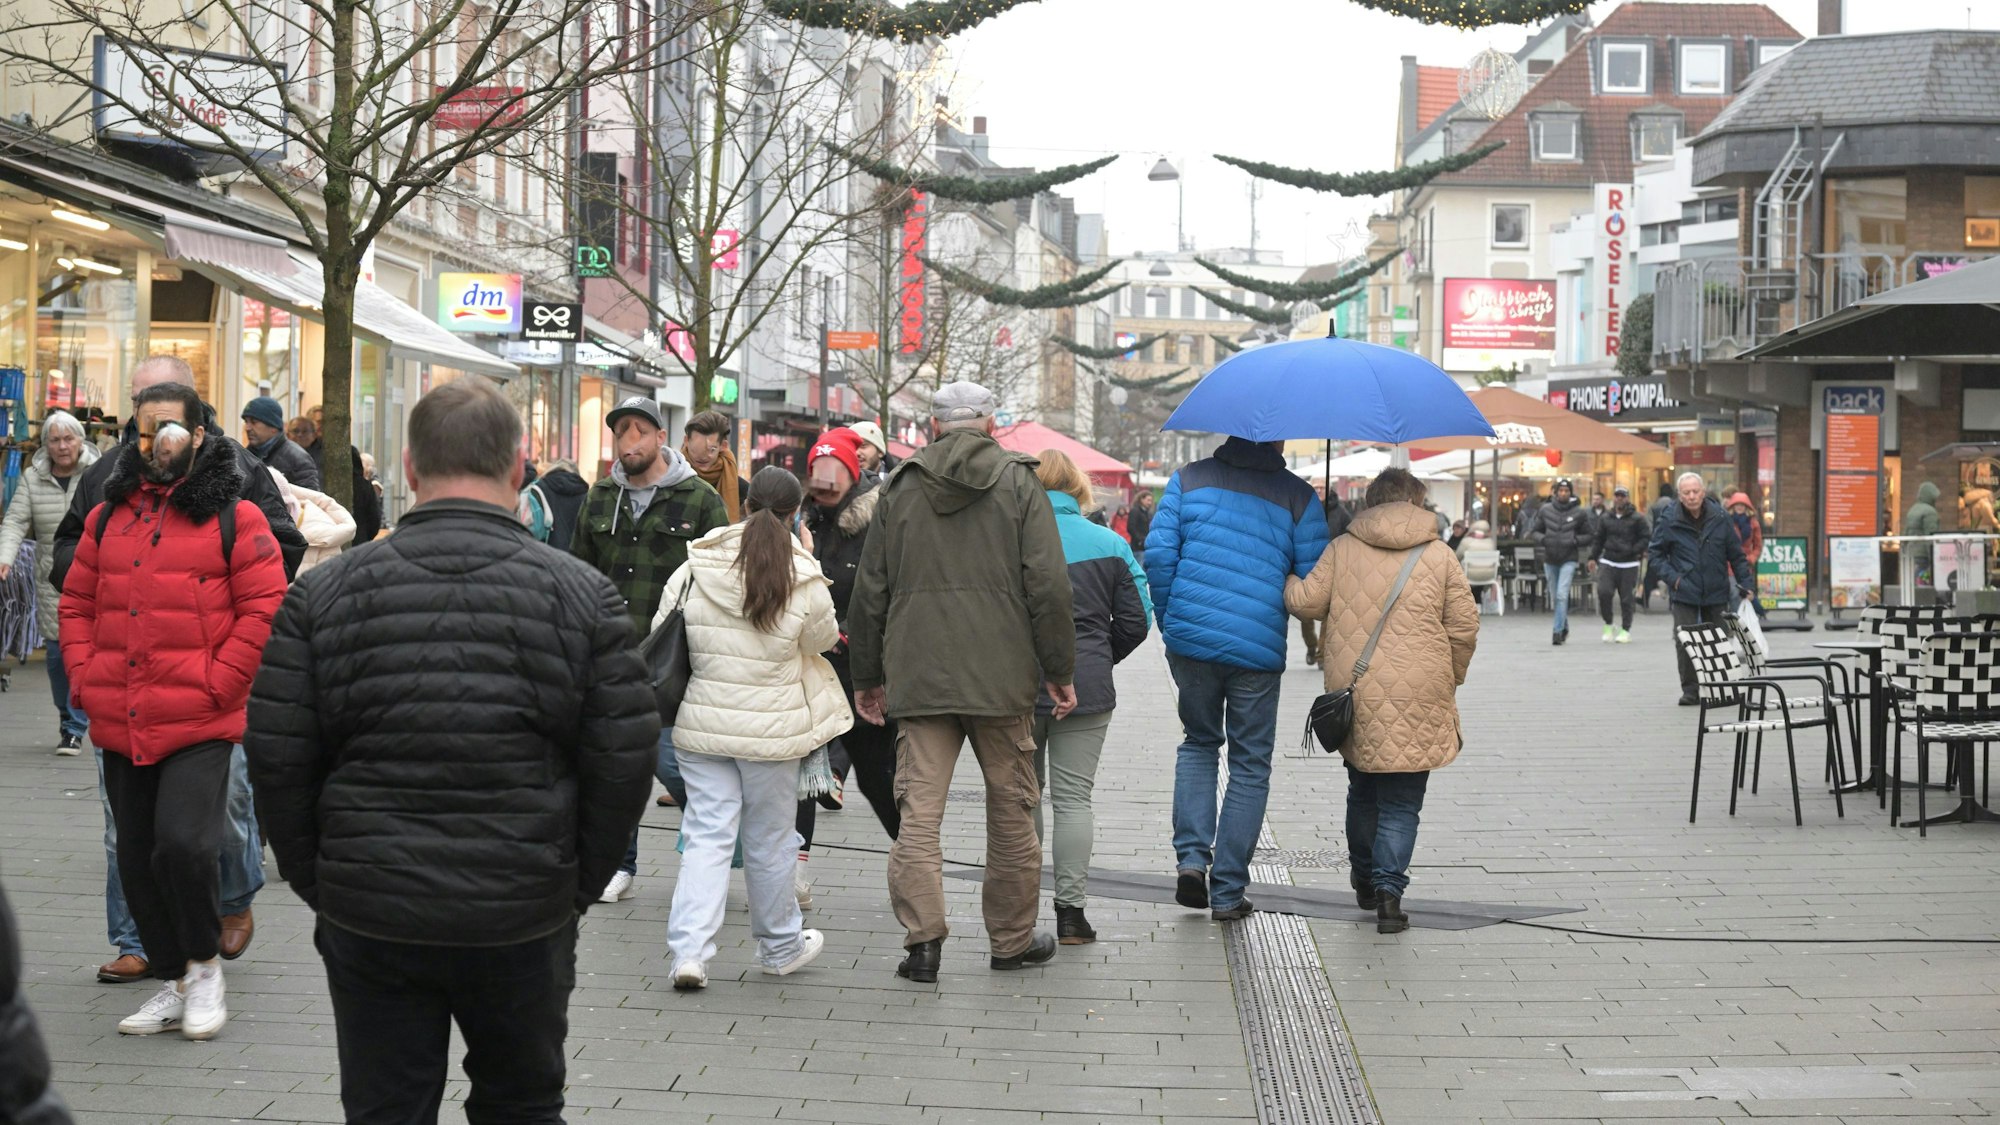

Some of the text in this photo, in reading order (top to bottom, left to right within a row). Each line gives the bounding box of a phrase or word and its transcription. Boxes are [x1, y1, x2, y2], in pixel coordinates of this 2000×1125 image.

[177, 97, 227, 127] Mode
[1605, 188, 1626, 358] RÖSELER
[463, 283, 503, 306] dm
[1570, 388, 1607, 411] PHONE
[1827, 389, 1881, 409] back
[1758, 545, 1806, 563] ASIA
[1778, 563, 1806, 573] SHOP
